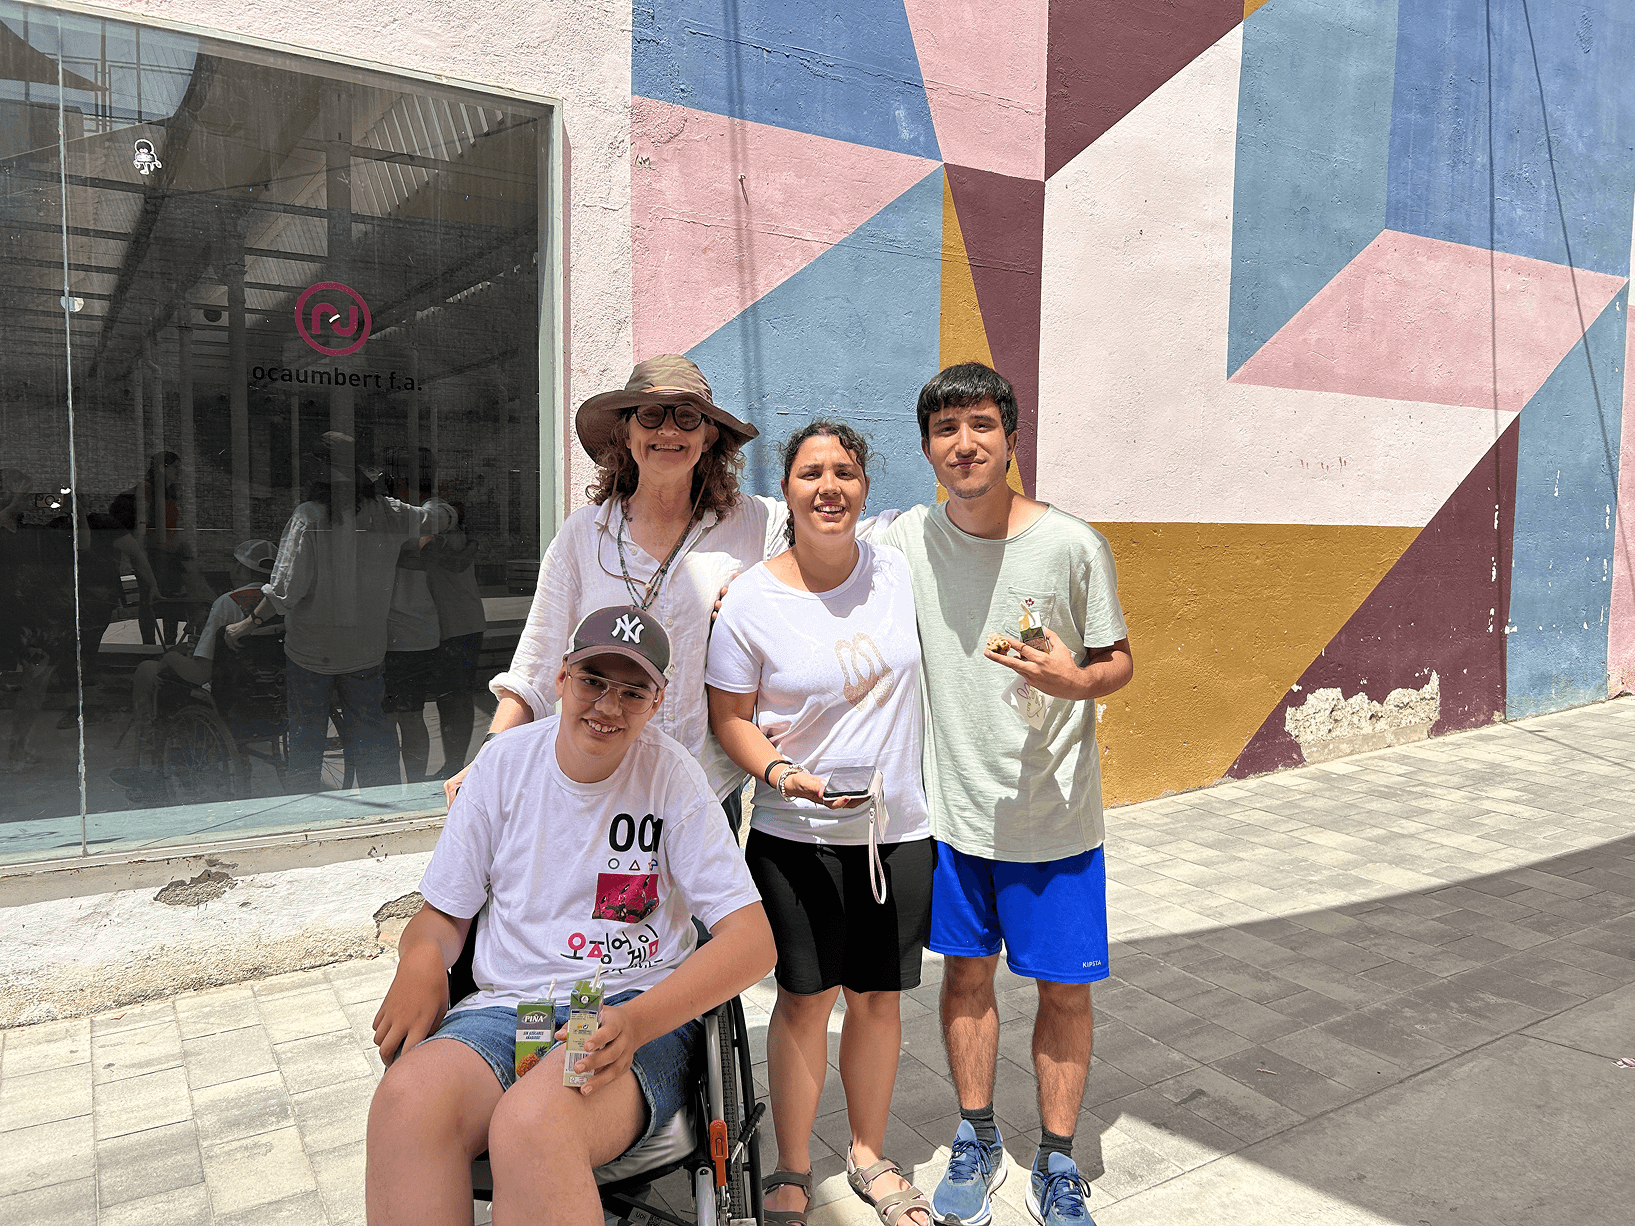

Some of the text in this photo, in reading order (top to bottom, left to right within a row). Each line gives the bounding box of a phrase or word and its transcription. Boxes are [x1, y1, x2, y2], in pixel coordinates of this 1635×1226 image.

[611, 613, 645, 644] NY
[560, 931, 632, 965] 오징어
[1082, 960, 1101, 968] KIPSTA
